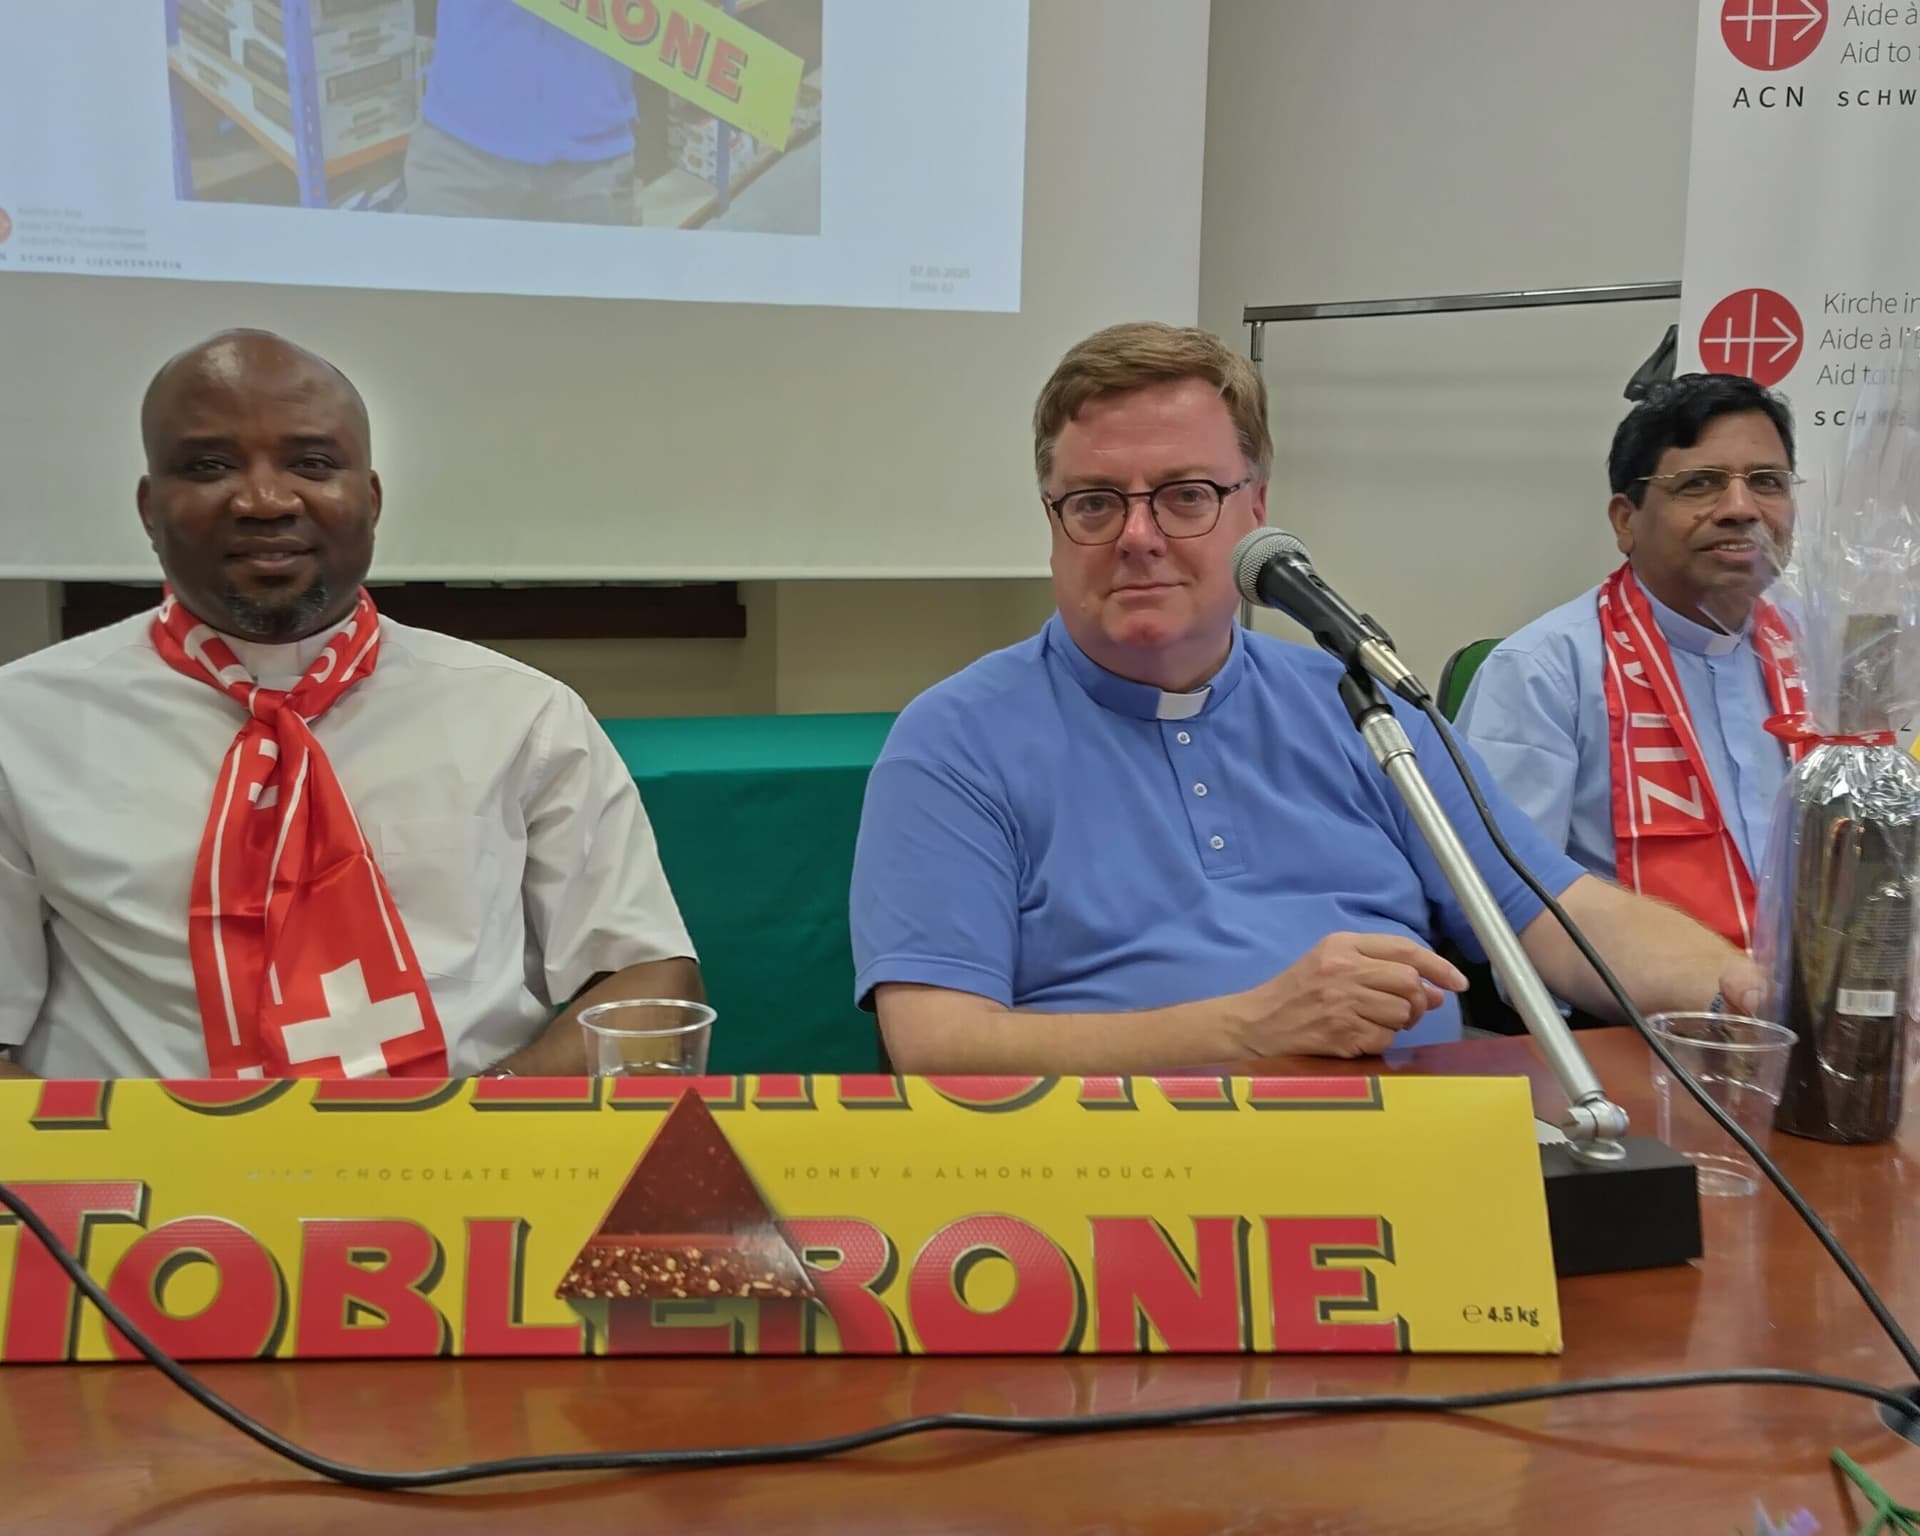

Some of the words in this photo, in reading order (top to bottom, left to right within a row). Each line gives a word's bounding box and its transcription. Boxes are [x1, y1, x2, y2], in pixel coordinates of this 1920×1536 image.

[1843, 2, 1898, 27] Aide
[1905, 1, 1918, 25] à
[1840, 39, 1880, 64] Aid
[1887, 41, 1911, 63] to
[1732, 86, 1804, 108] ACN
[1837, 89, 1917, 107] SCHW
[1824, 291, 1898, 314] Kirche
[1820, 327, 1873, 350] Aide
[1879, 327, 1892, 350] à
[1816, 362, 1856, 385] Aid
[336, 1168, 510, 1181] CHOCOLATE
[532, 1167, 601, 1181] WITH
[784, 1166, 881, 1180] HONEY
[902, 1167, 913, 1180] &
[935, 1166, 1055, 1180] ALMOND
[1076, 1166, 1194, 1180] NOUGAT
[1487, 1306, 1514, 1323] 4.5
[1517, 1305, 1540, 1328] kg
